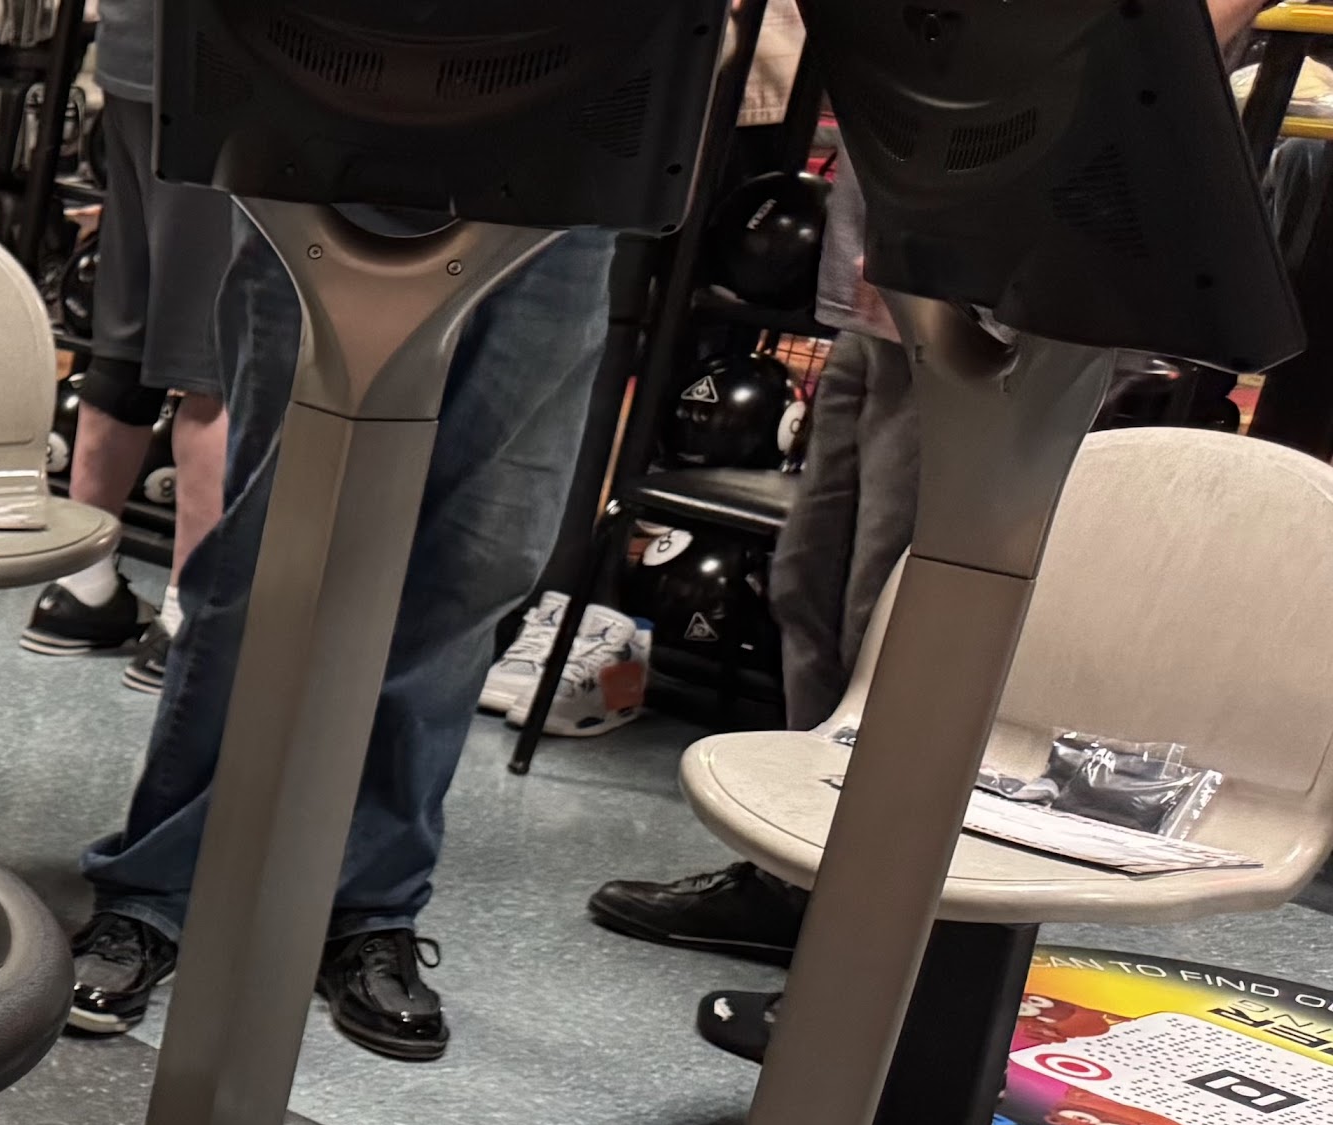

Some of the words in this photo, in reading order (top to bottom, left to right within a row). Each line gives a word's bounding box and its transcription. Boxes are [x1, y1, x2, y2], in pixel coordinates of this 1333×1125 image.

[1109, 960, 1167, 978] TO
[1179, 969, 1280, 998] FIND
[1295, 993, 1333, 1011] O
[1208, 1007, 1333, 1056] ER
